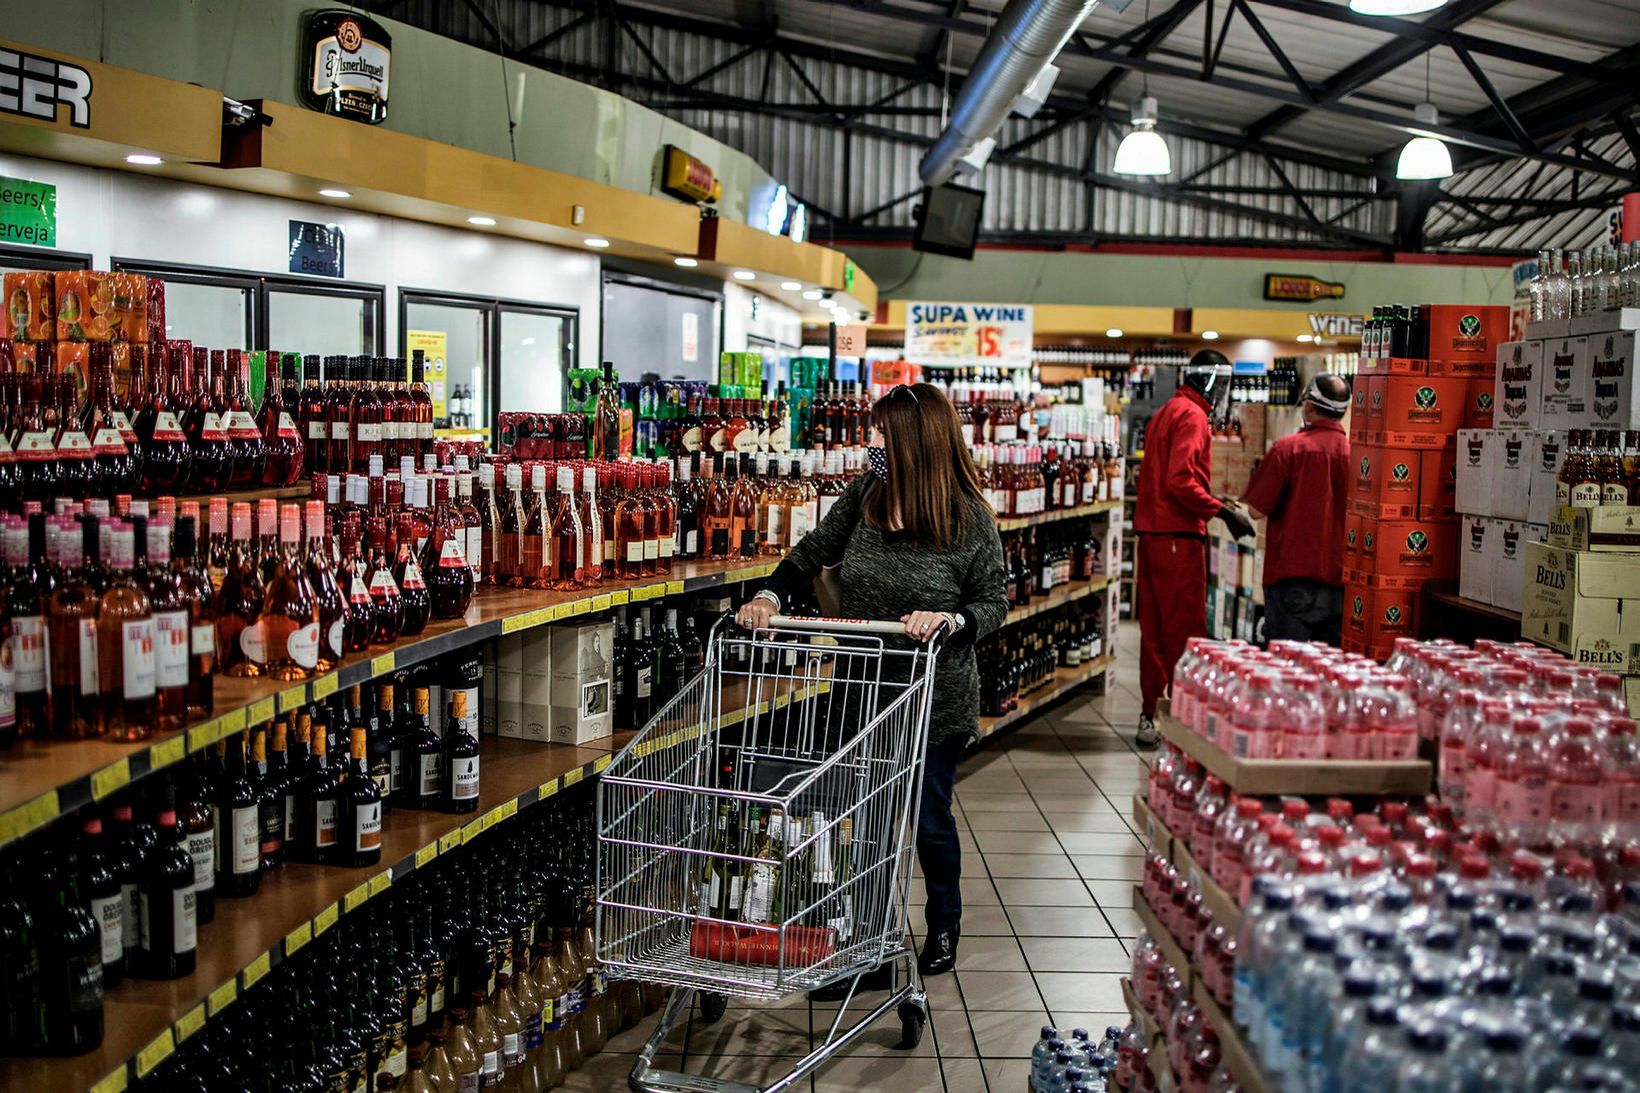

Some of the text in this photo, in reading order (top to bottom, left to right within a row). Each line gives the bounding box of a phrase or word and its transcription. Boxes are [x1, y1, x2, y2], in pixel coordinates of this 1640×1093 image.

[0, 190, 46, 211] eers/
[912, 304, 1025, 324] SUPA WINE
[1550, 521, 1571, 536] BELL'S
[1535, 565, 1566, 590] BELL'S
[1579, 650, 1623, 664] BELL'S
